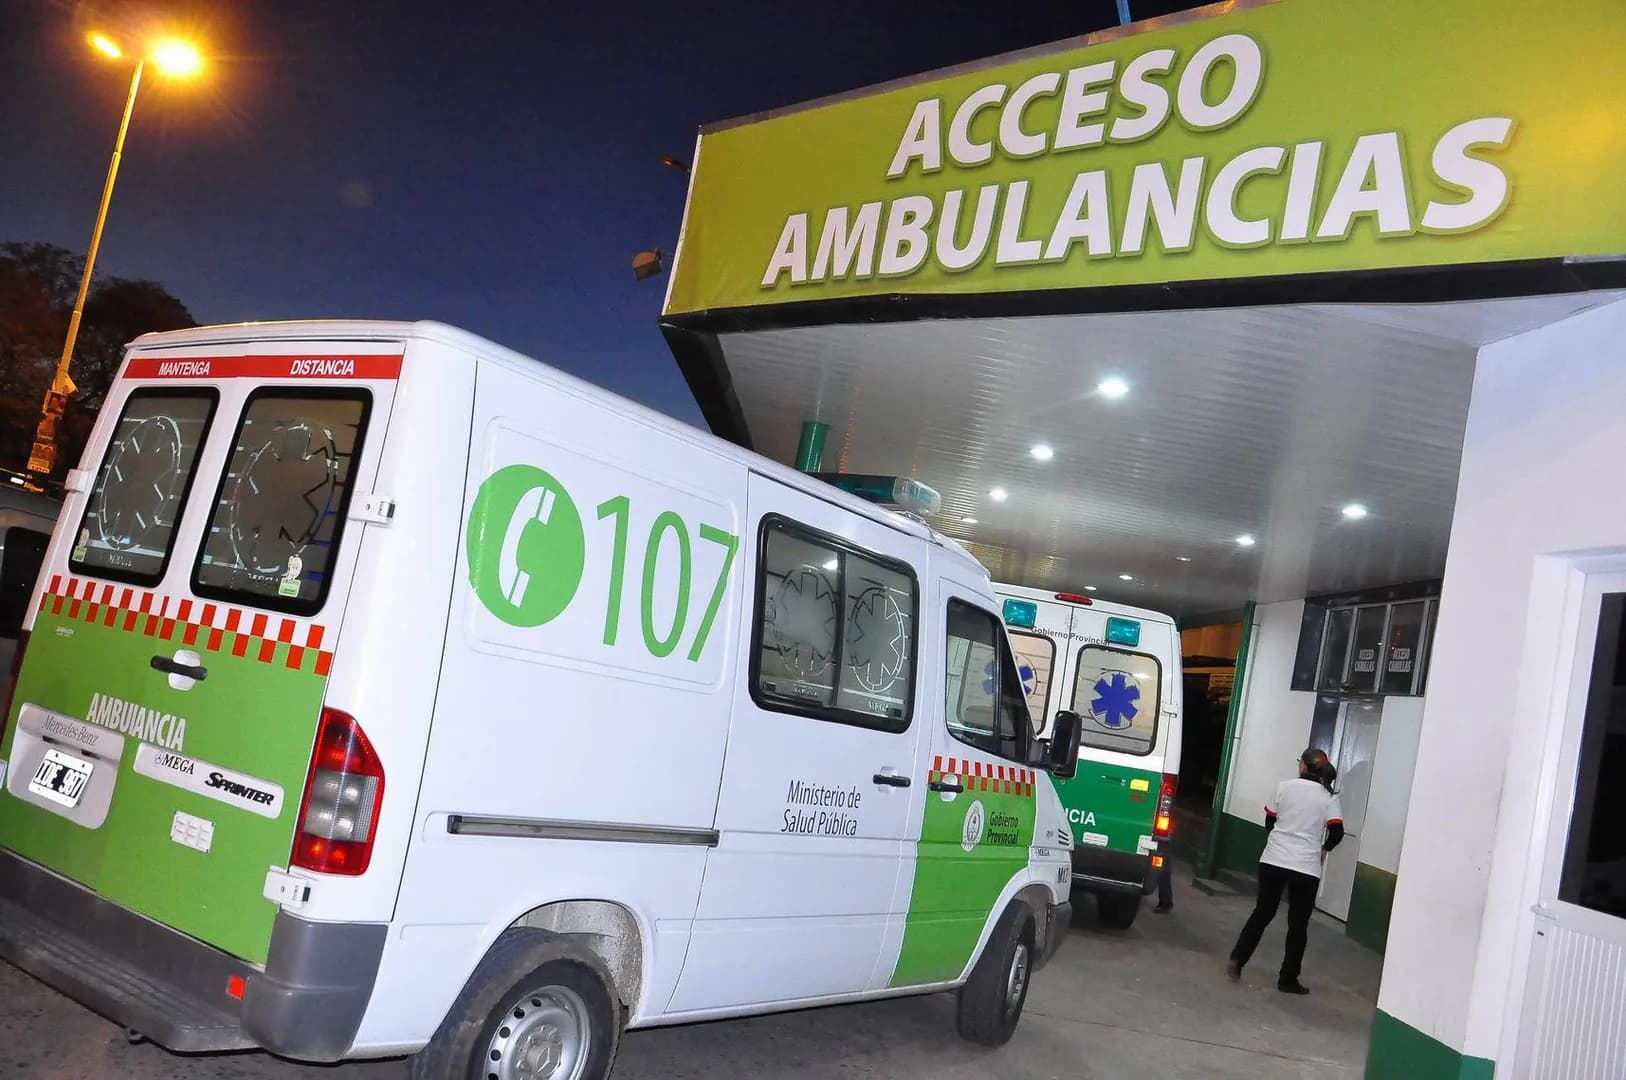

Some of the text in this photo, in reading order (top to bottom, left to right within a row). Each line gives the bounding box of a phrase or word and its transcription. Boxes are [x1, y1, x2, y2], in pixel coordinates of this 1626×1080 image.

[887, 33, 1263, 178] ACCESO
[761, 117, 1514, 288] AMBULANCIAS
[158, 359, 355, 376] MANTENGA DISTANCIA
[597, 495, 740, 663] 107
[1031, 625, 1069, 640] Gobierno
[86, 692, 186, 752] AMBULANCIA
[204, 772, 275, 806] SPRINTER
[787, 779, 861, 809] Ministerio de
[781, 808, 858, 836] Salud Pública
[989, 811, 1019, 828] Gobierno
[987, 828, 1019, 845] Provincial
